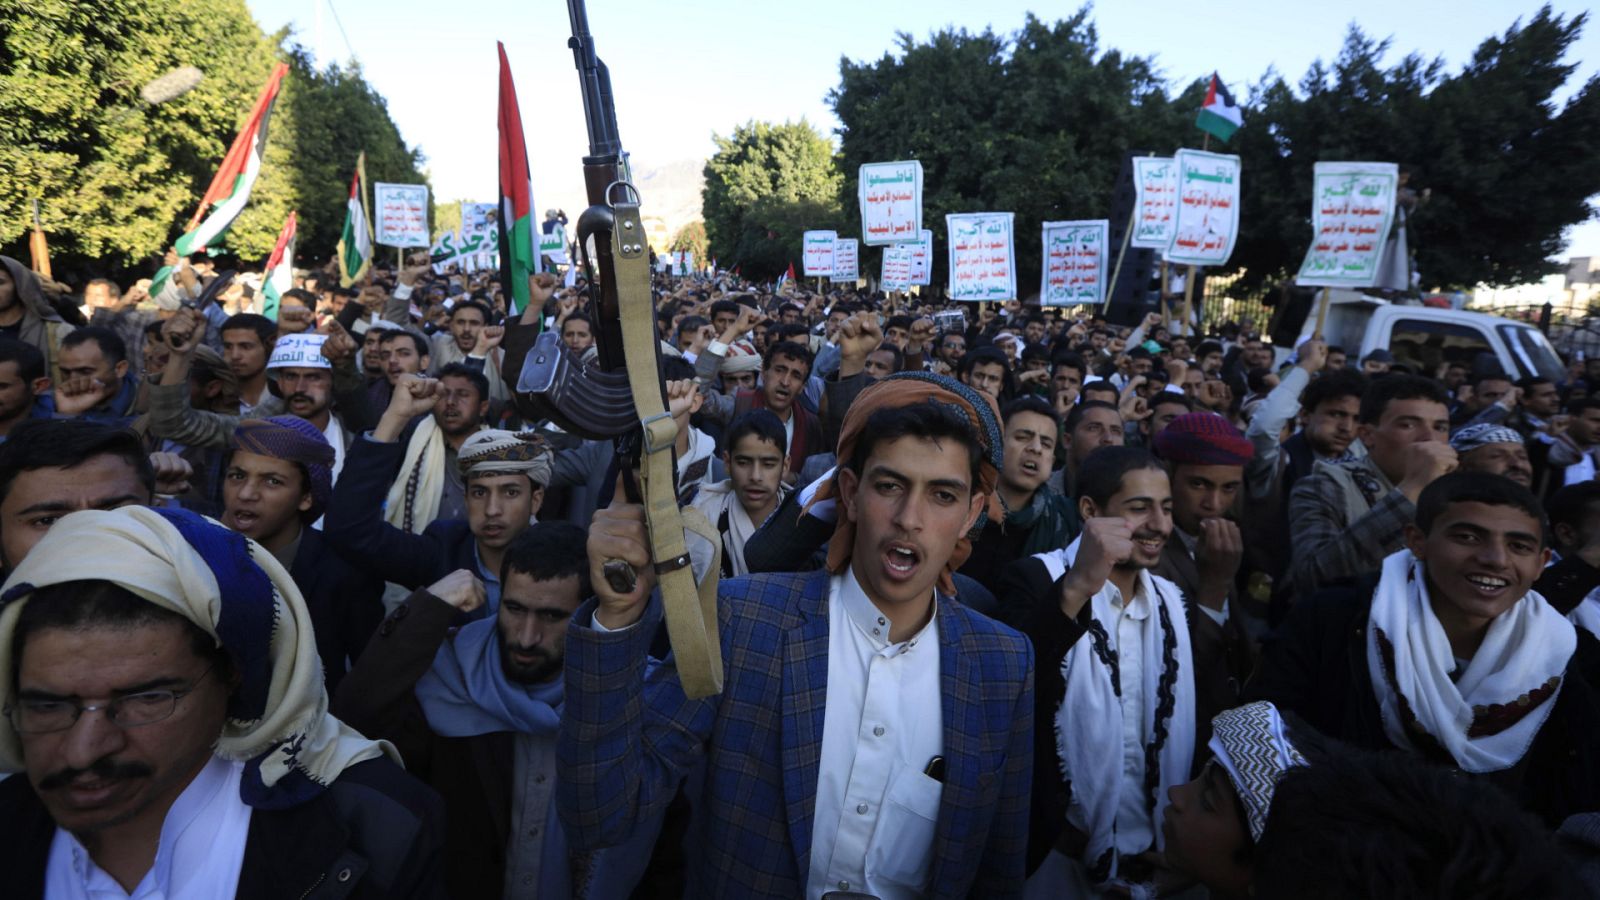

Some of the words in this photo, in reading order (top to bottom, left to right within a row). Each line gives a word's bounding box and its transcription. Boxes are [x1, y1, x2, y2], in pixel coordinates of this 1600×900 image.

[1359, 178, 1387, 197] الله
[986, 220, 1006, 234] الله
[1081, 230, 1101, 242] الله
